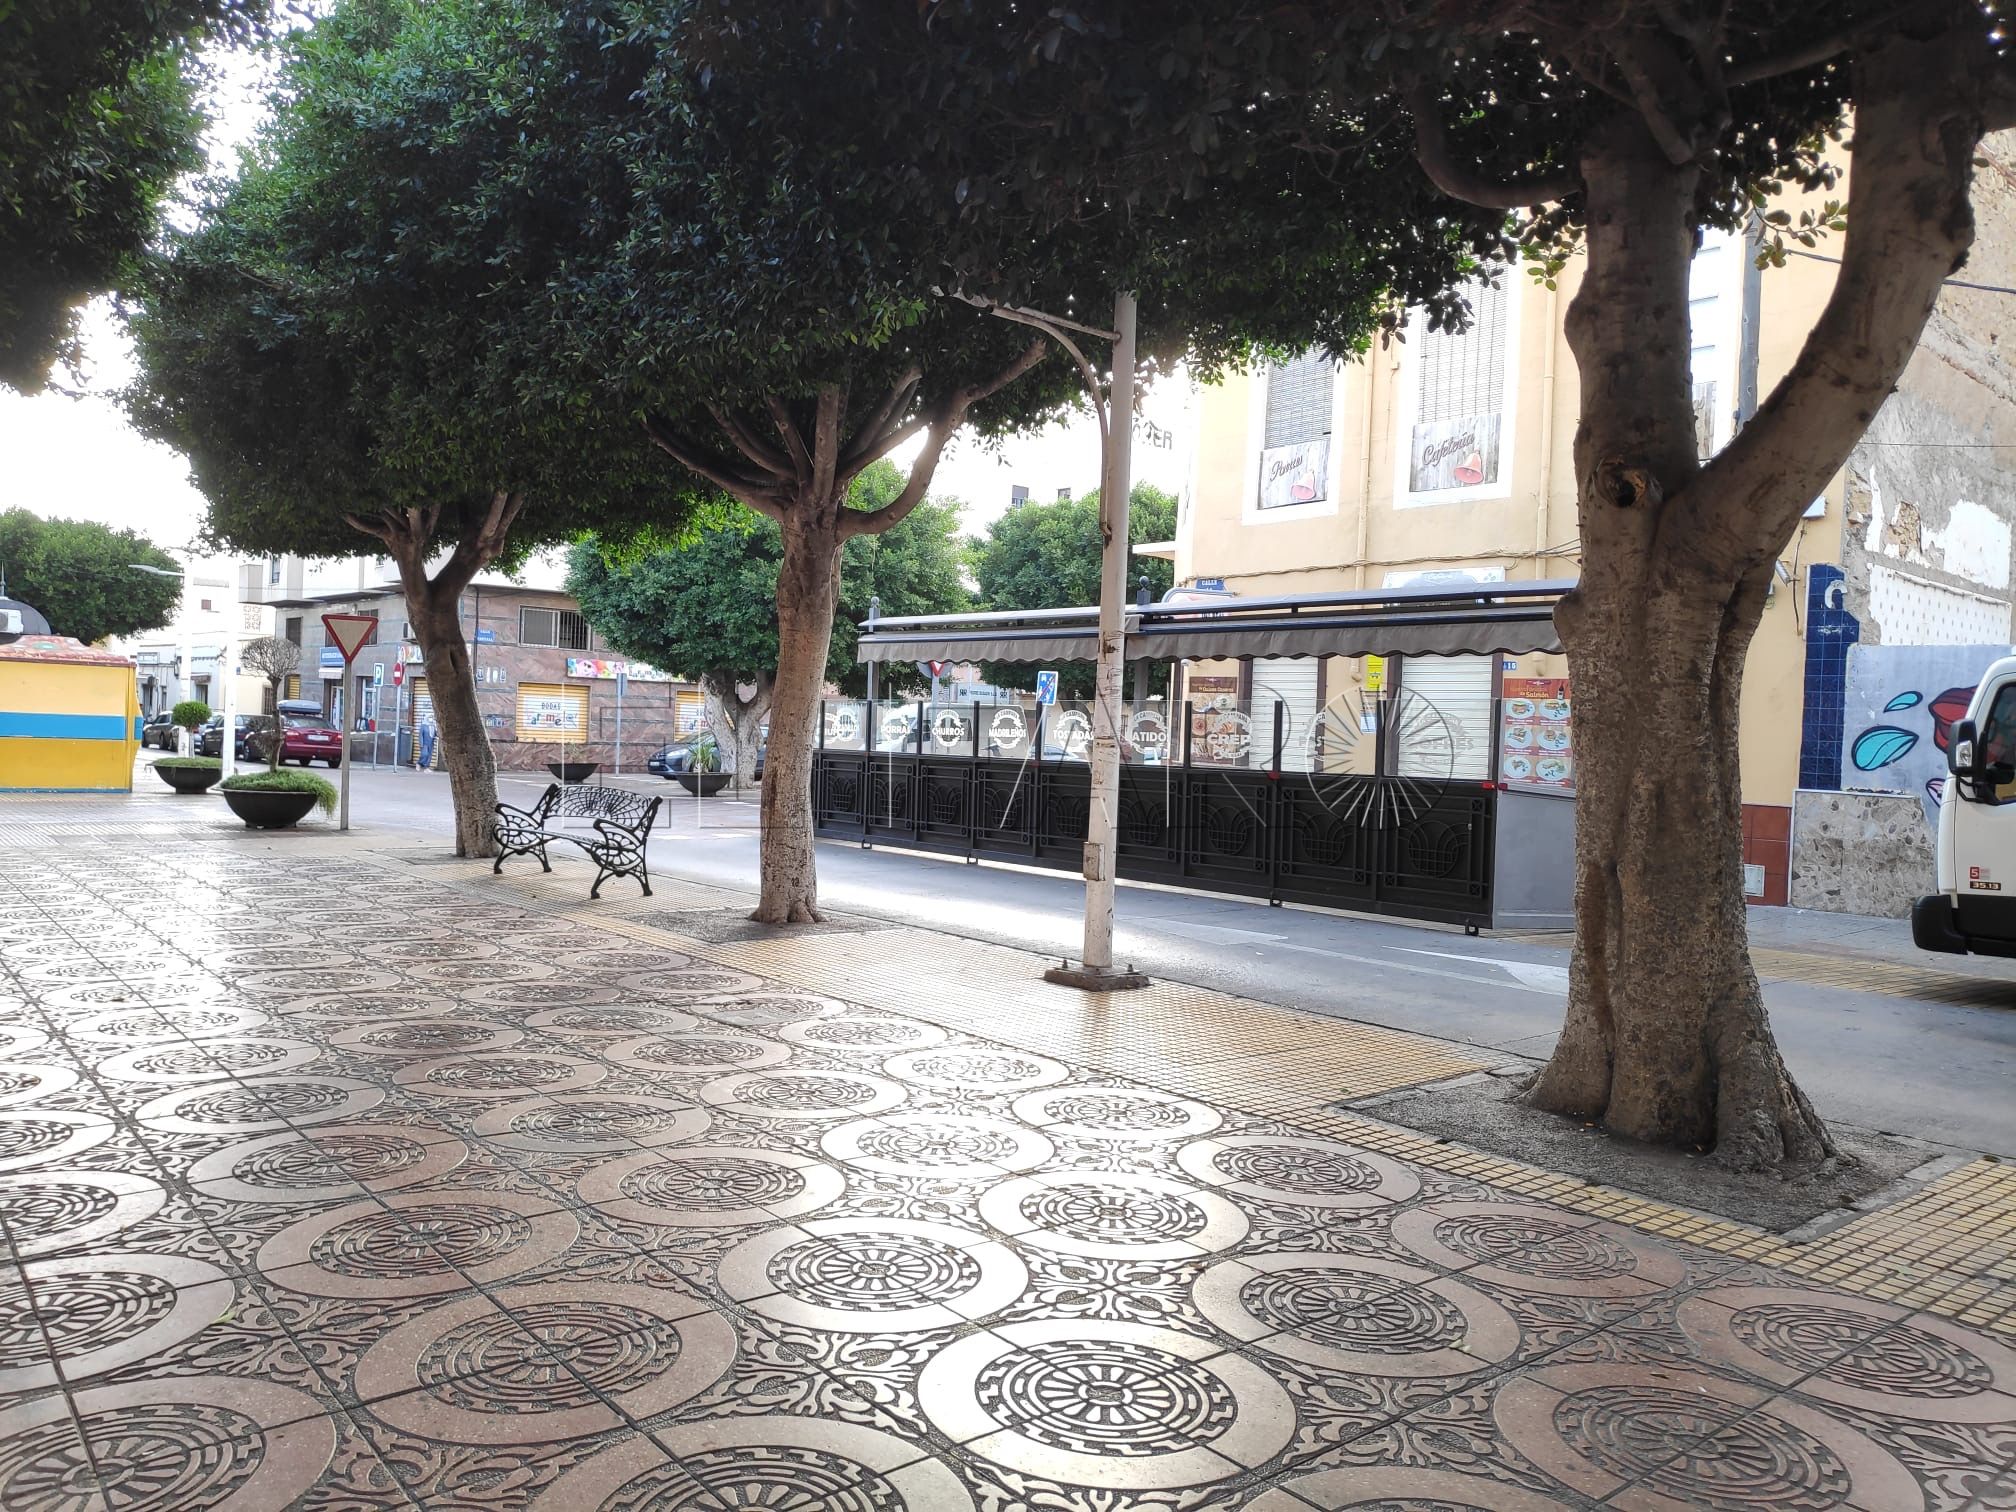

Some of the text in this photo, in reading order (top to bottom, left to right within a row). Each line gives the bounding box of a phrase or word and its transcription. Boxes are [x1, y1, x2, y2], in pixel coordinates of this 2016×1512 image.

[1422, 431, 1475, 467] Cafetería
[1526, 690, 1550, 699] Salmón
[541, 702, 561, 710] BODAS
[931, 727, 966, 736] CHURROS
[988, 726, 1027, 738] MADRILEÑOS
[1971, 868, 1979, 878] 5
